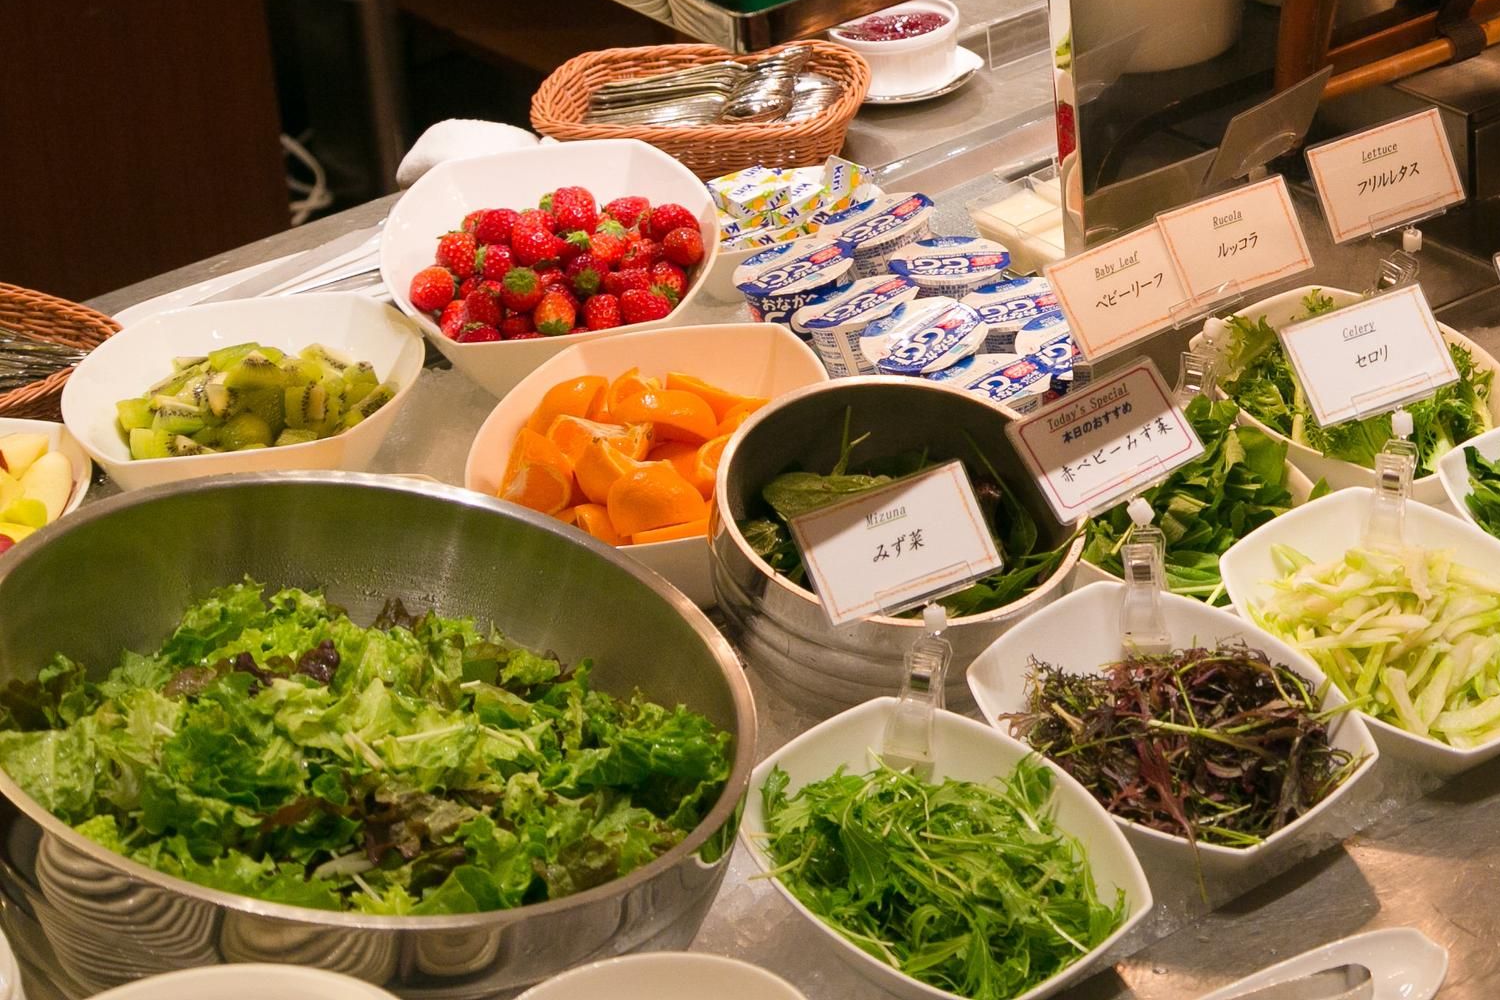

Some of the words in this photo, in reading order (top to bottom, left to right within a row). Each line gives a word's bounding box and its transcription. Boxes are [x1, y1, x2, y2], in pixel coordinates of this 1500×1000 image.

[1362, 143, 1398, 162] Lettuce
[833, 164, 845, 191] kiri
[1357, 161, 1420, 196] フリルレタス
[1212, 209, 1242, 227] Rucola
[1217, 231, 1258, 258] ルッコラ
[1094, 263, 1115, 279] Baby
[1119, 250, 1138, 267] Leaf
[1095, 272, 1164, 309] ベビーリーフ
[1342, 321, 1375, 339] Celery
[1355, 343, 1388, 368] セロリ
[1046, 403, 1087, 431] Today's
[1089, 382, 1129, 410] Special
[1061, 400, 1134, 445] 本日のおすすめ
[865, 505, 907, 528] Mizuna
[872, 527, 926, 563] みず菜
